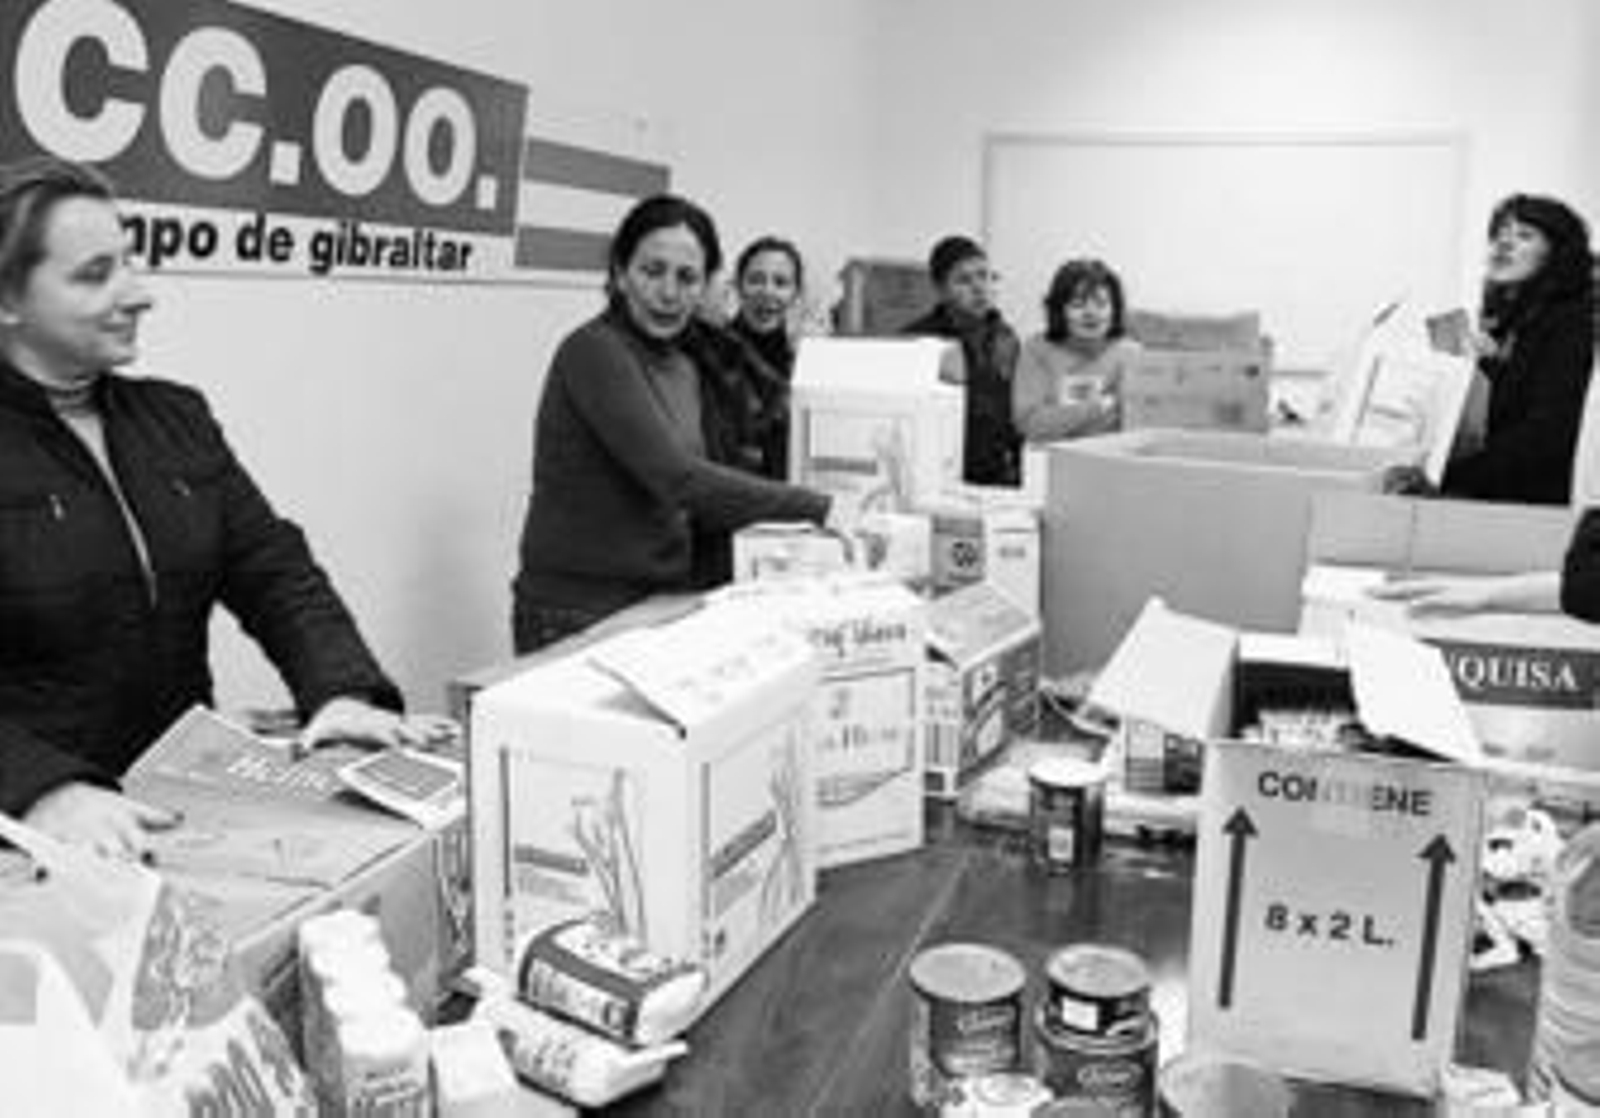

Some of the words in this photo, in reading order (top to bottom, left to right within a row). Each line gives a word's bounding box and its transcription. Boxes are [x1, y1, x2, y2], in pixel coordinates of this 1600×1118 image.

[14, 0, 498, 209] CC.OO.
[236, 212, 294, 261] de
[309, 219, 473, 275] gibraltar
[1450, 653, 1579, 692] QUISA
[1258, 771, 1434, 817] CONENE
[1265, 902, 1288, 931] 8
[1297, 914, 1317, 937] x
[1329, 909, 1351, 940] 2
[1362, 915, 1393, 947] L.
